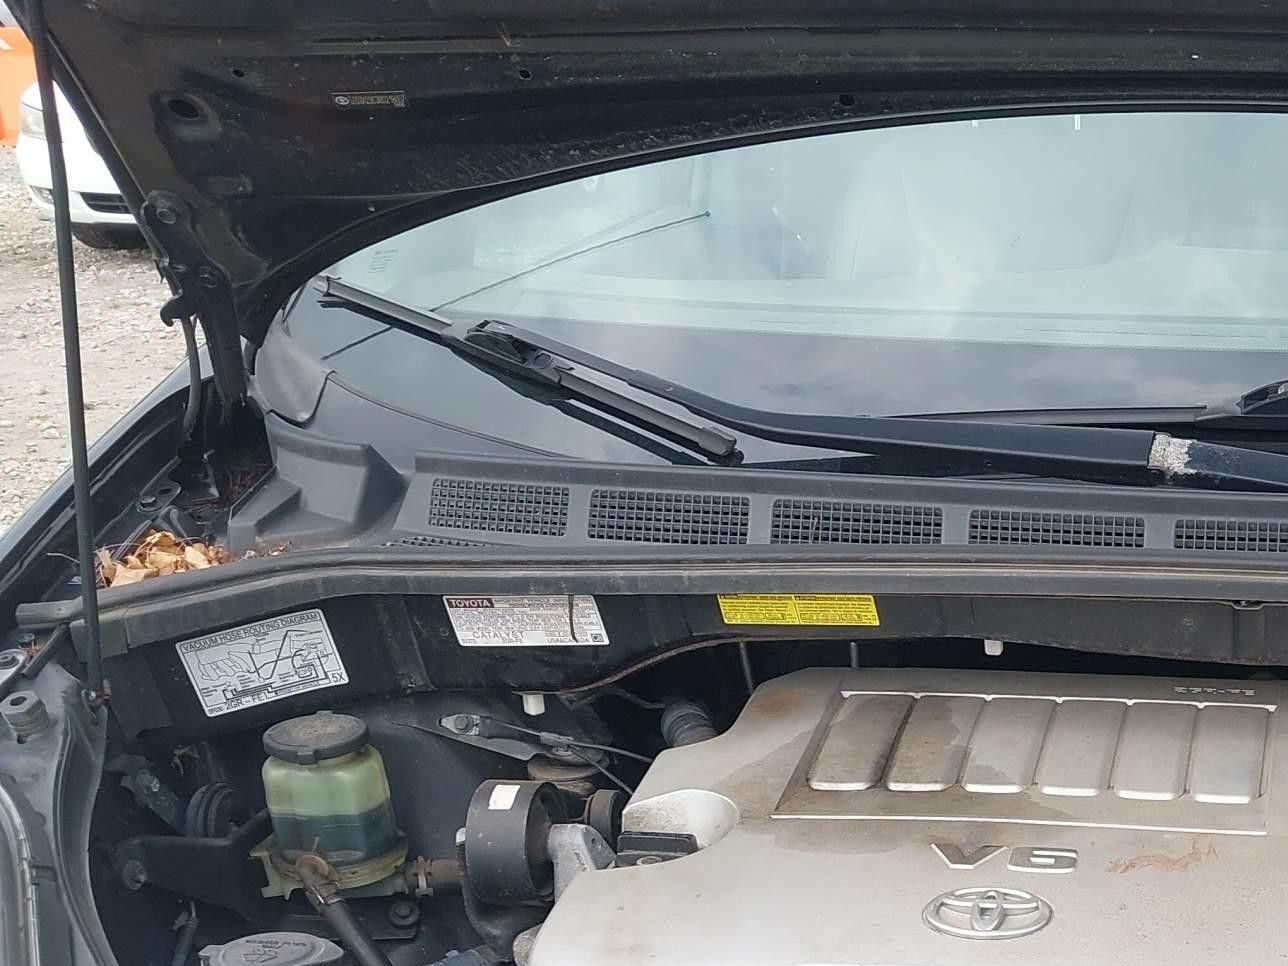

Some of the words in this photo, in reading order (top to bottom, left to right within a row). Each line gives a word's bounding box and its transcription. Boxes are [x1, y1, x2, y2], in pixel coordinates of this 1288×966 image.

[449, 599, 491, 608] TOYOTA
[183, 636, 219, 652] VACUUM
[218, 630, 243, 644] HOSE
[244, 621, 281, 638] ROUTING
[281, 612, 319, 627] DIAGRAM
[472, 631, 524, 640] CATALYST
[331, 671, 345, 684] 5X
[930, 842, 1080, 874] V6
